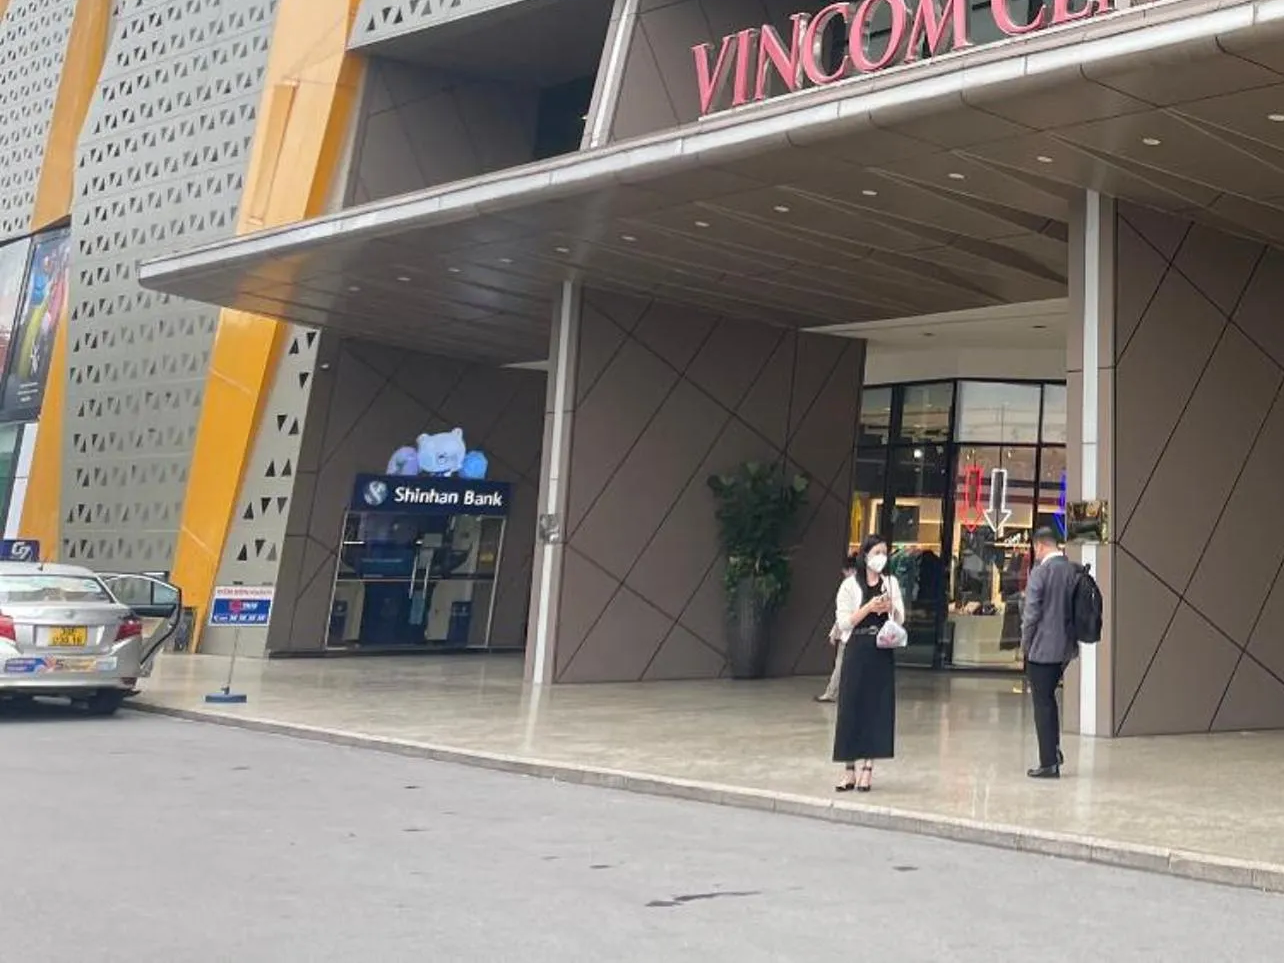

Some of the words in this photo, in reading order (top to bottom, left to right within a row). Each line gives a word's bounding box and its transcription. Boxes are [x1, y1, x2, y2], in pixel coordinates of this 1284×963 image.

[394, 486, 458, 505] Shinhan
[463, 489, 503, 507] Bank
[11, 541, 32, 560] G7
